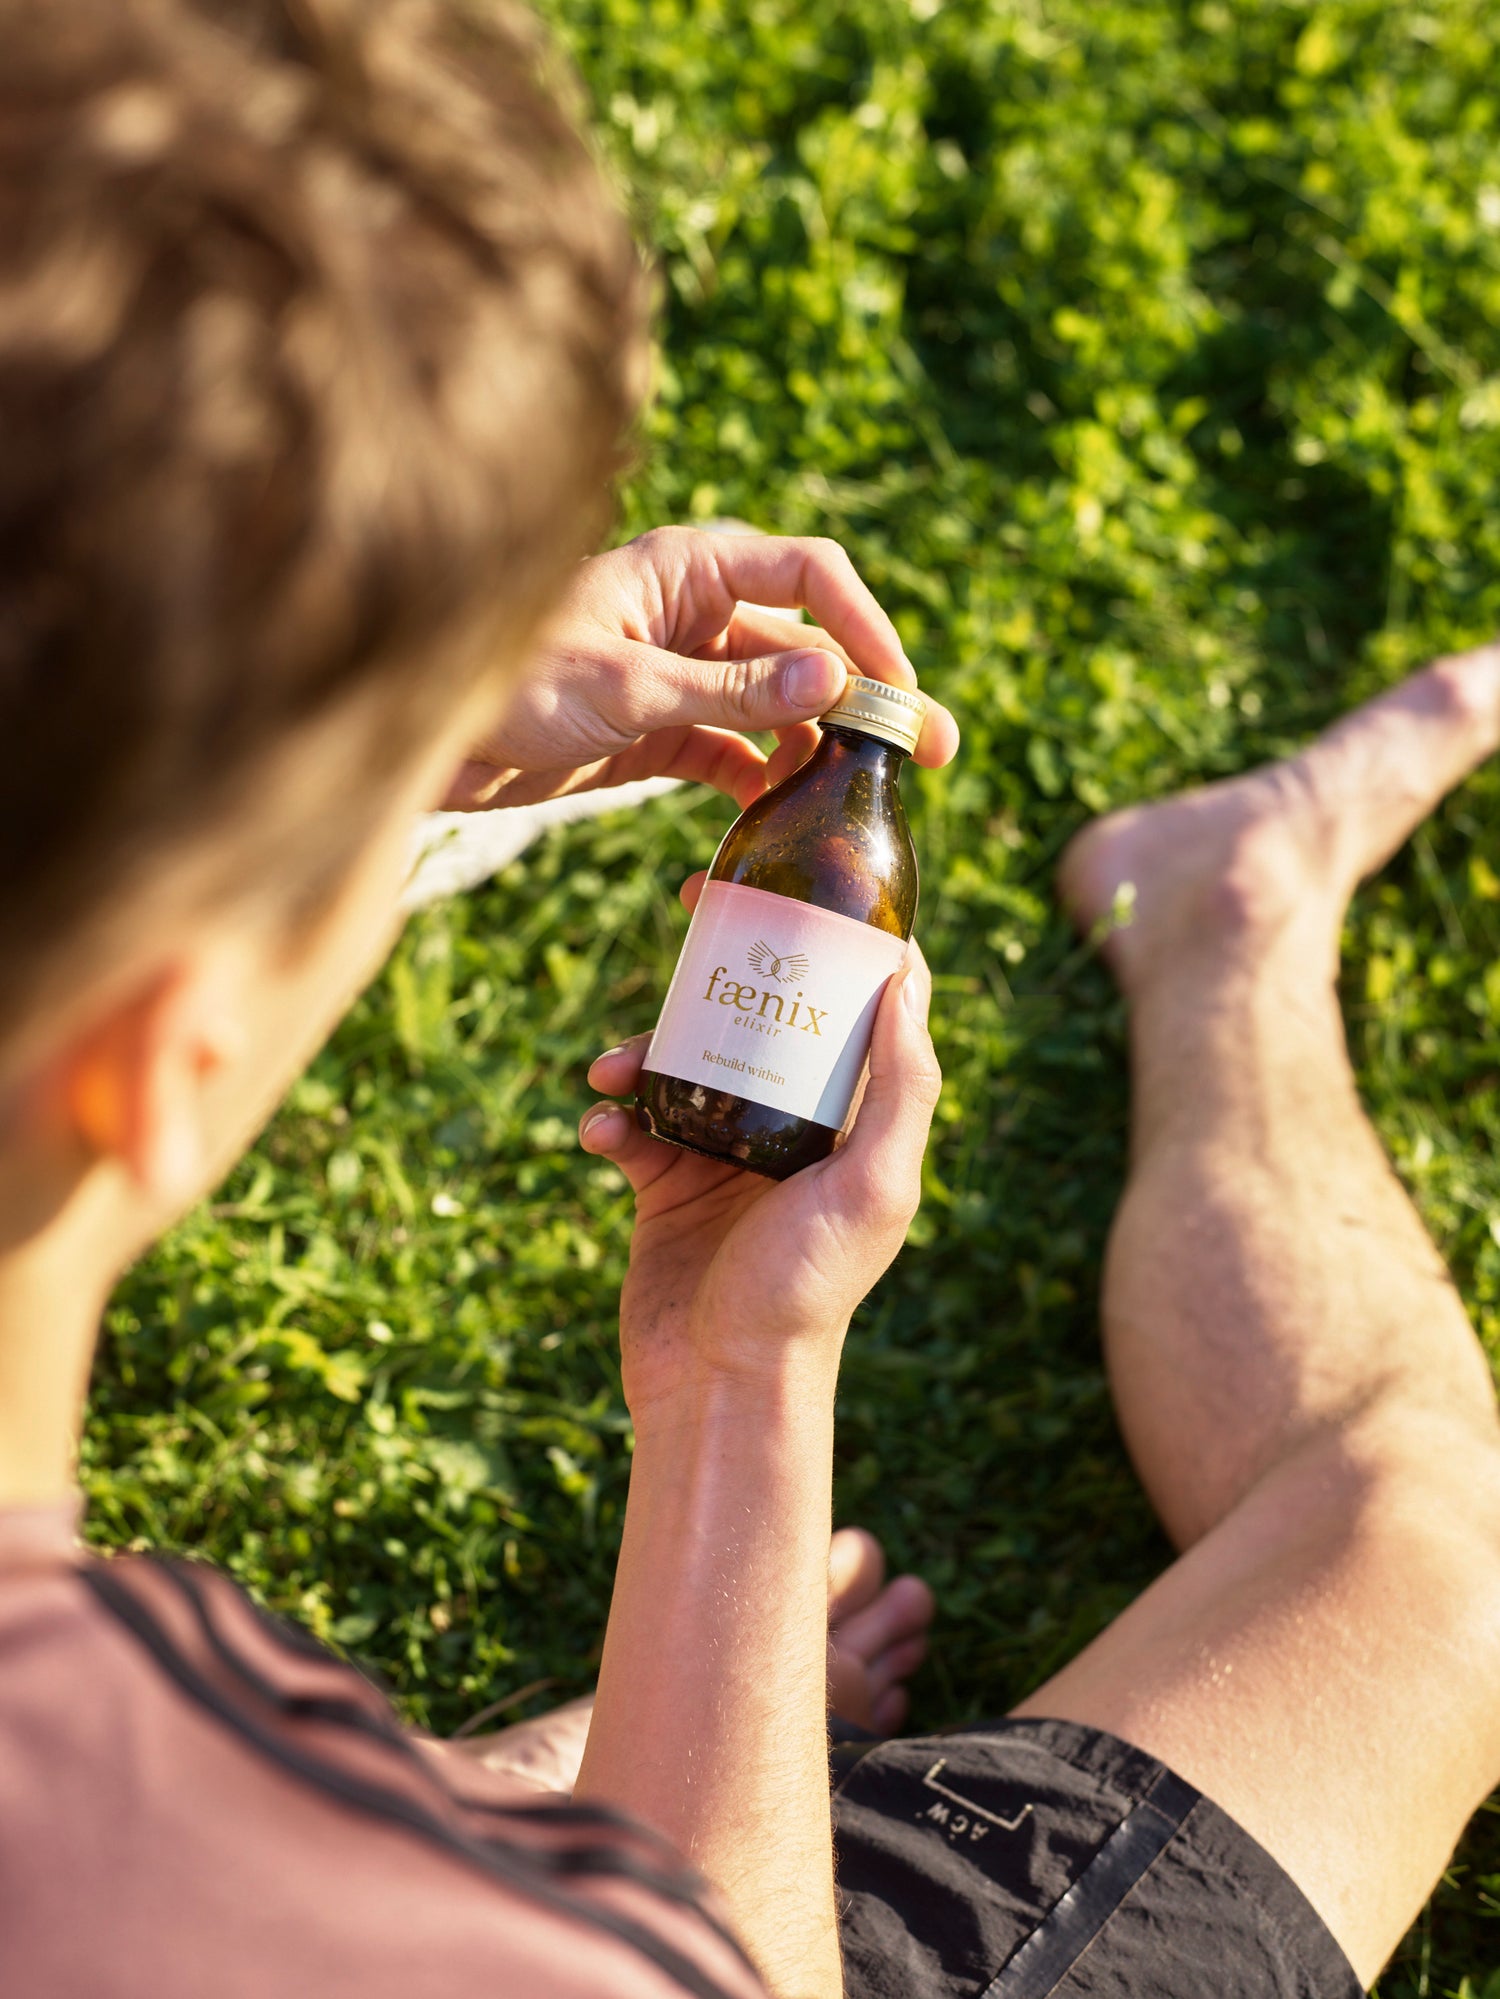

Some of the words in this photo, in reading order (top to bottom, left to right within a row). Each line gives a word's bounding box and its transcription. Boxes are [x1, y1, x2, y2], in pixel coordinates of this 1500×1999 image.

[703, 967, 828, 1035] fænix
[734, 1017, 782, 1037] elixir
[702, 1050, 746, 1073] Rebuild
[748, 1065, 786, 1086] within
